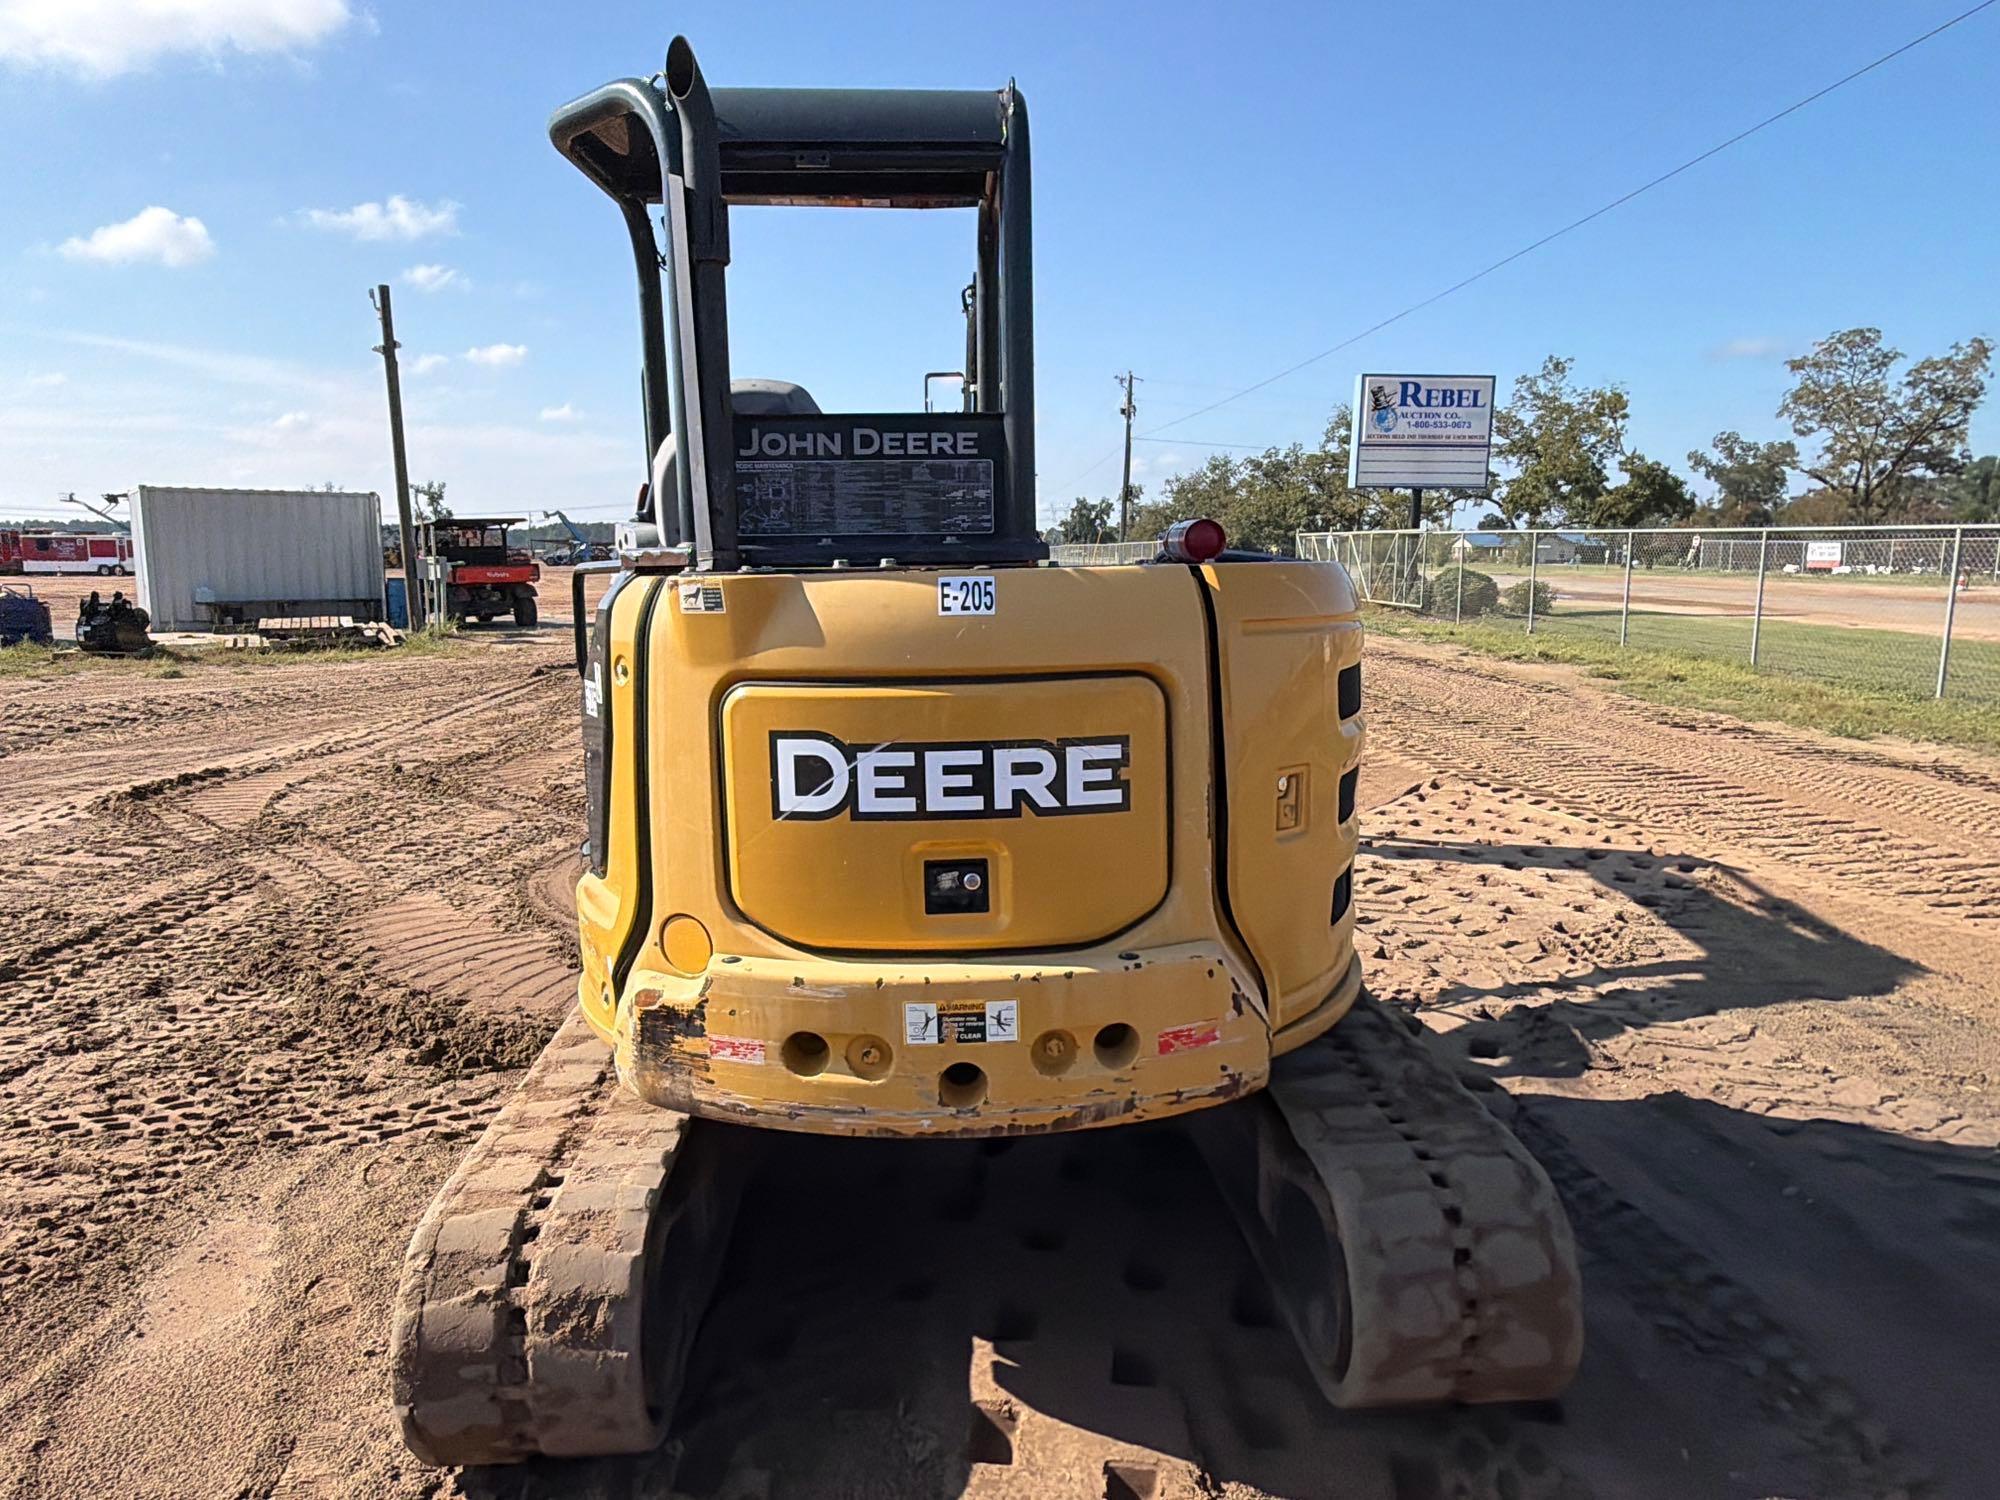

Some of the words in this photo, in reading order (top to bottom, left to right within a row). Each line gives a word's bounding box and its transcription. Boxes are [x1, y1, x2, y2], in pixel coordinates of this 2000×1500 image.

[1398, 381, 1487, 408] REBEL
[739, 428, 842, 457] JOHN
[853, 428, 979, 456] DEERE
[941, 582, 994, 612] E-205
[776, 738, 1123, 813] DEERE
